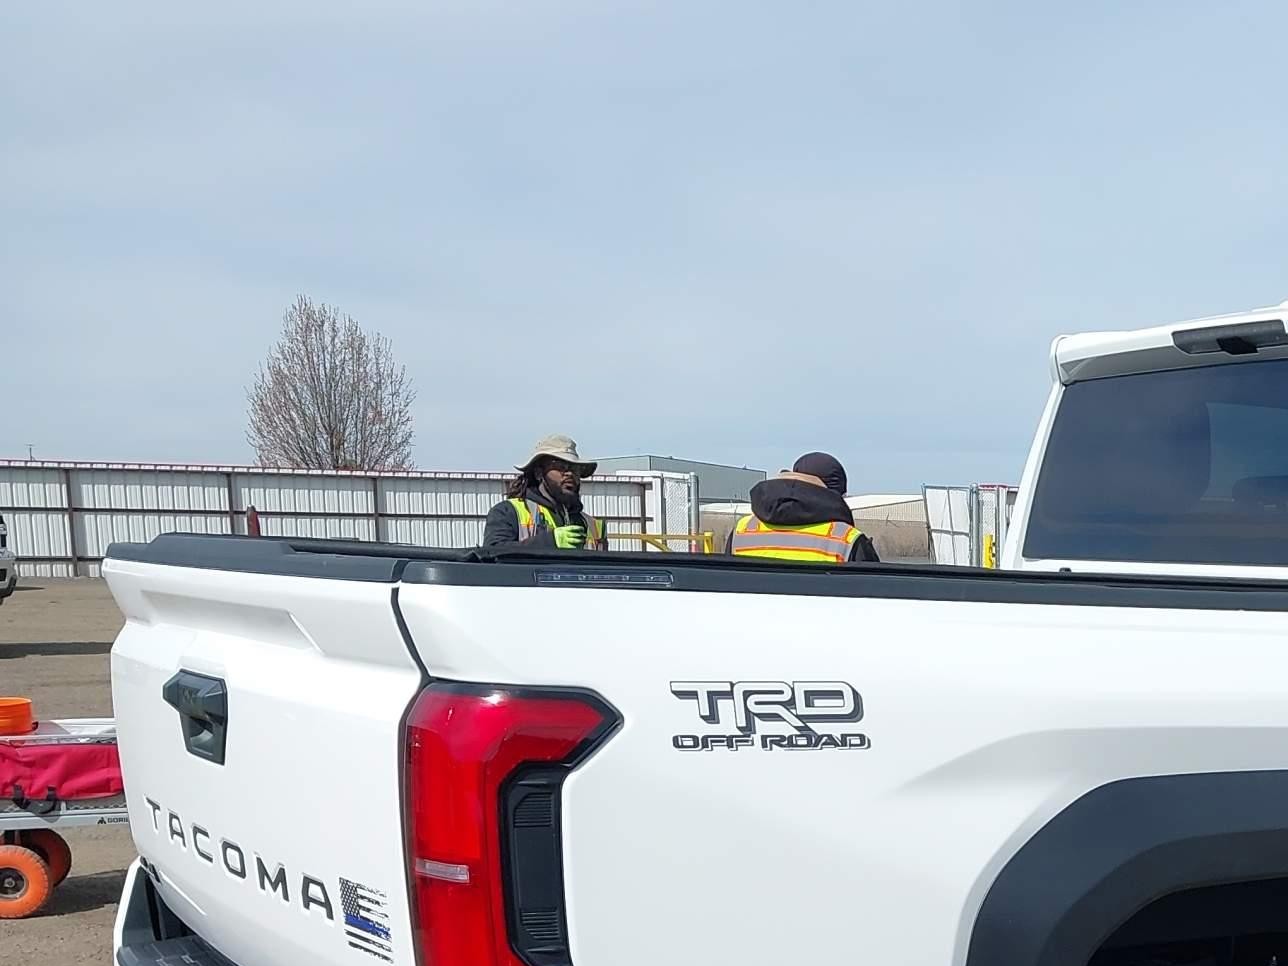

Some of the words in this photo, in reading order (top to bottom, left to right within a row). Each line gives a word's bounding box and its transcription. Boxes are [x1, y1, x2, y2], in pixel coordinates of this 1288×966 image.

[669, 680, 865, 735] TRD
[672, 734, 755, 751] OFF
[760, 733, 872, 751] ROAD
[145, 796, 334, 922] TACOMA
